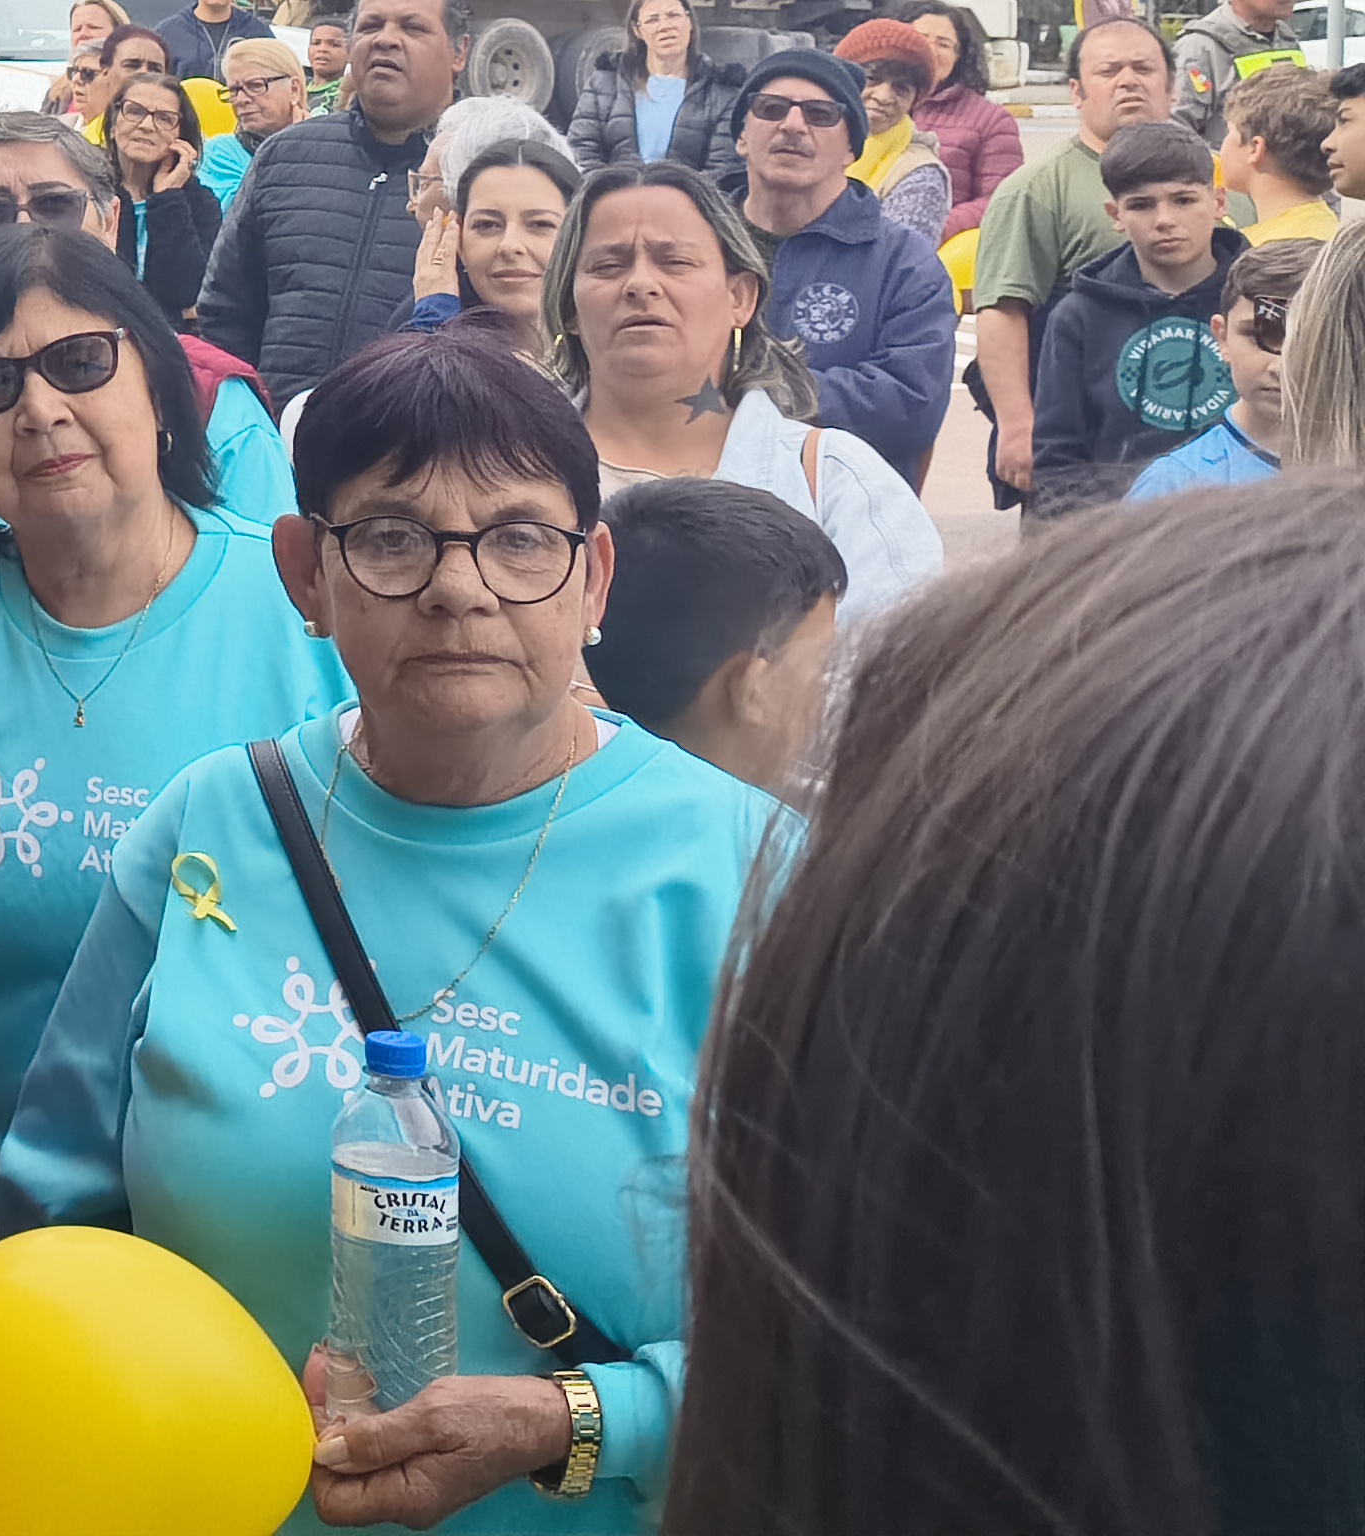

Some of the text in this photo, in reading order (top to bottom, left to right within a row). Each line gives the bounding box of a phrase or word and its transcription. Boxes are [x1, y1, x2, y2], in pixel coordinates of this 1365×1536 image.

[85, 776, 150, 808] Sesc
[430, 988, 521, 1036] Sesc
[425, 1032, 663, 1117] Maturidade
[374, 1192, 447, 1214] CRISTAL
[379, 1212, 443, 1234] TERRA
